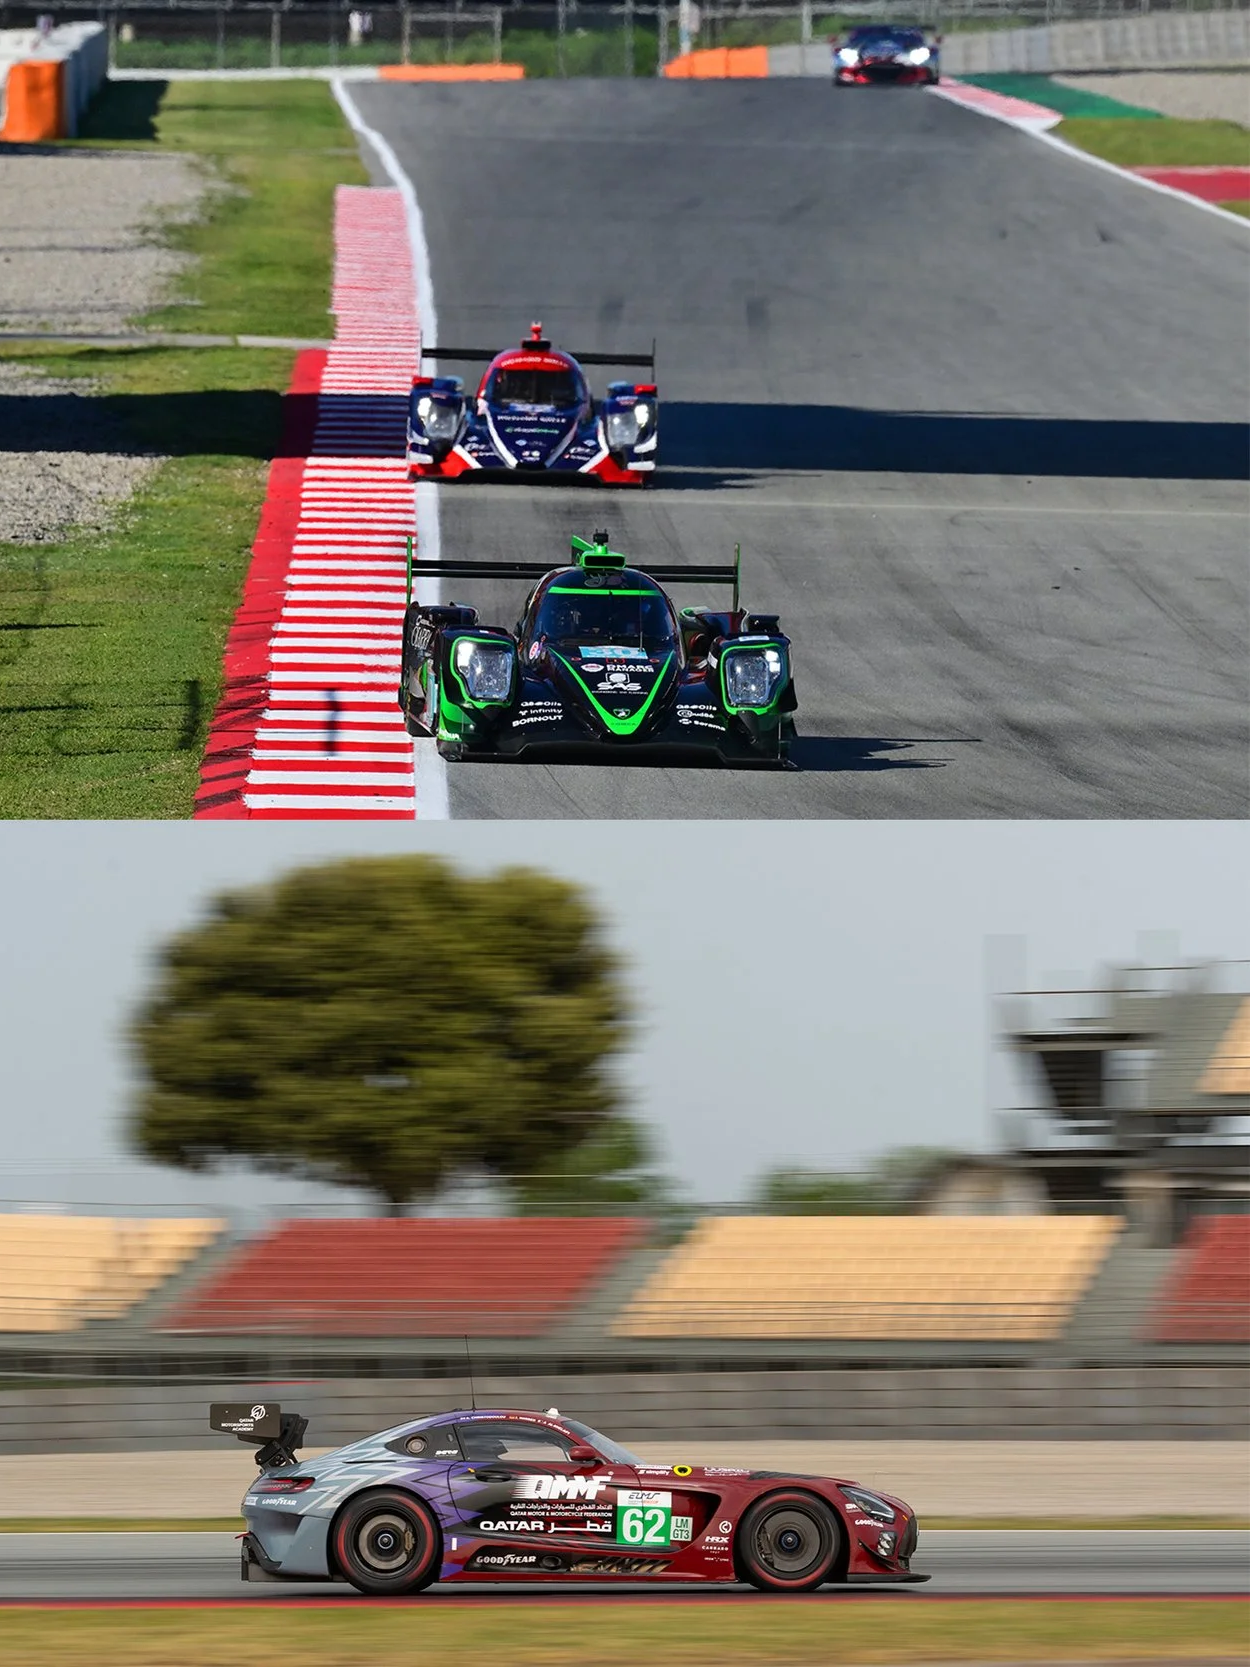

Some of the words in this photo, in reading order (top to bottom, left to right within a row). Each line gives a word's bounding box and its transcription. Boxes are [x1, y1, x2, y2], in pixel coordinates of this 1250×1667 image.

[597, 682, 642, 691] SAS
[480, 1521, 544, 1531] QATAR
[548, 1520, 612, 1533] قطر
[622, 1508, 666, 1542] 62
[675, 1518, 689, 1528] LM
[672, 1528, 690, 1539] GT3
[476, 1554, 537, 1566] GOODYEAR
